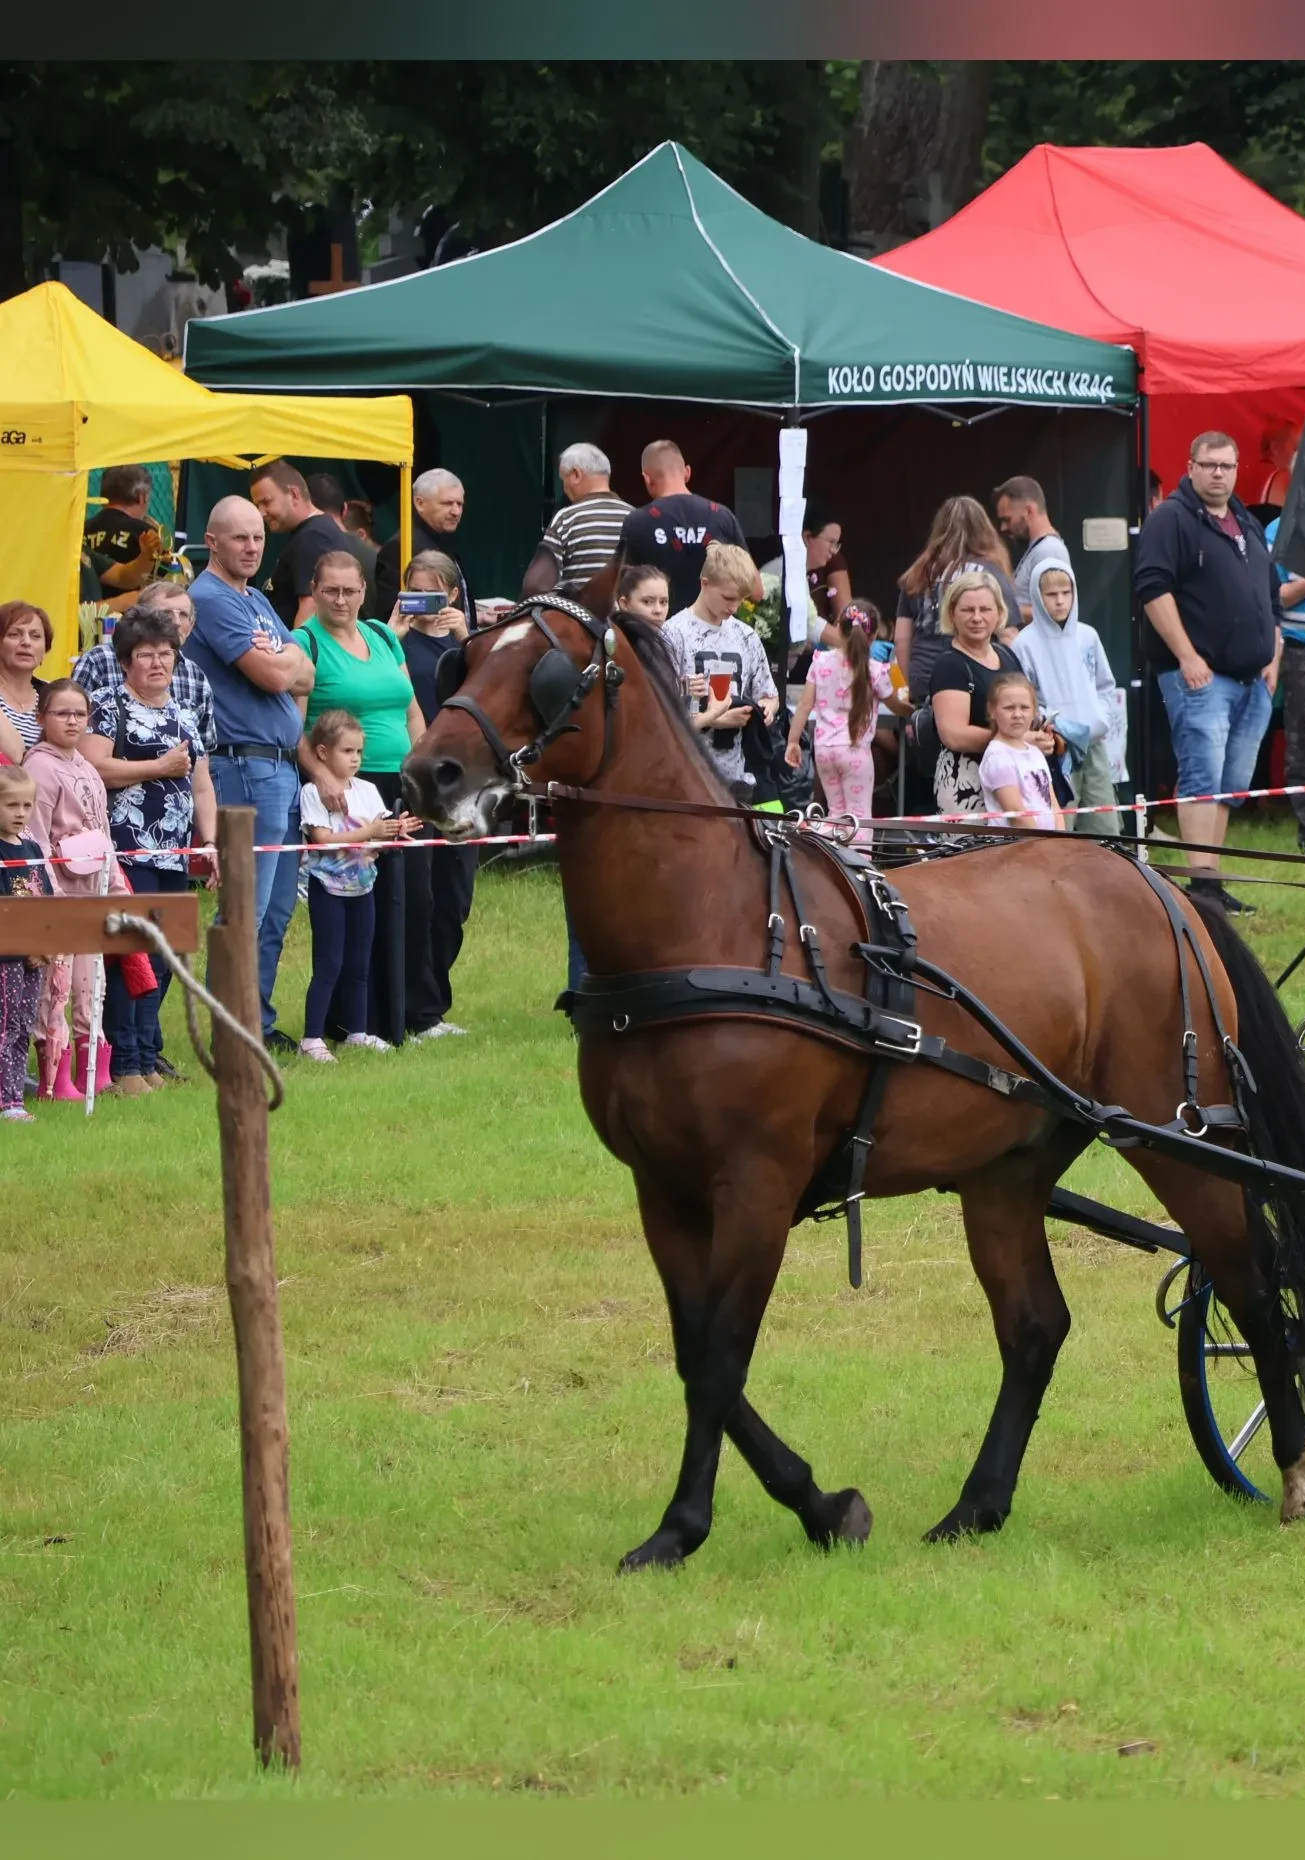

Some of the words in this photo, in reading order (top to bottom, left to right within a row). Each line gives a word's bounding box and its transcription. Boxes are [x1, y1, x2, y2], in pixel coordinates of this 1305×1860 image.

[828, 365, 875, 394] KOŁO
[879, 358, 975, 392] GOSPODYŃ
[976, 364, 1067, 396] WIEJSKICH
[1068, 371, 1116, 404] KRĄG
